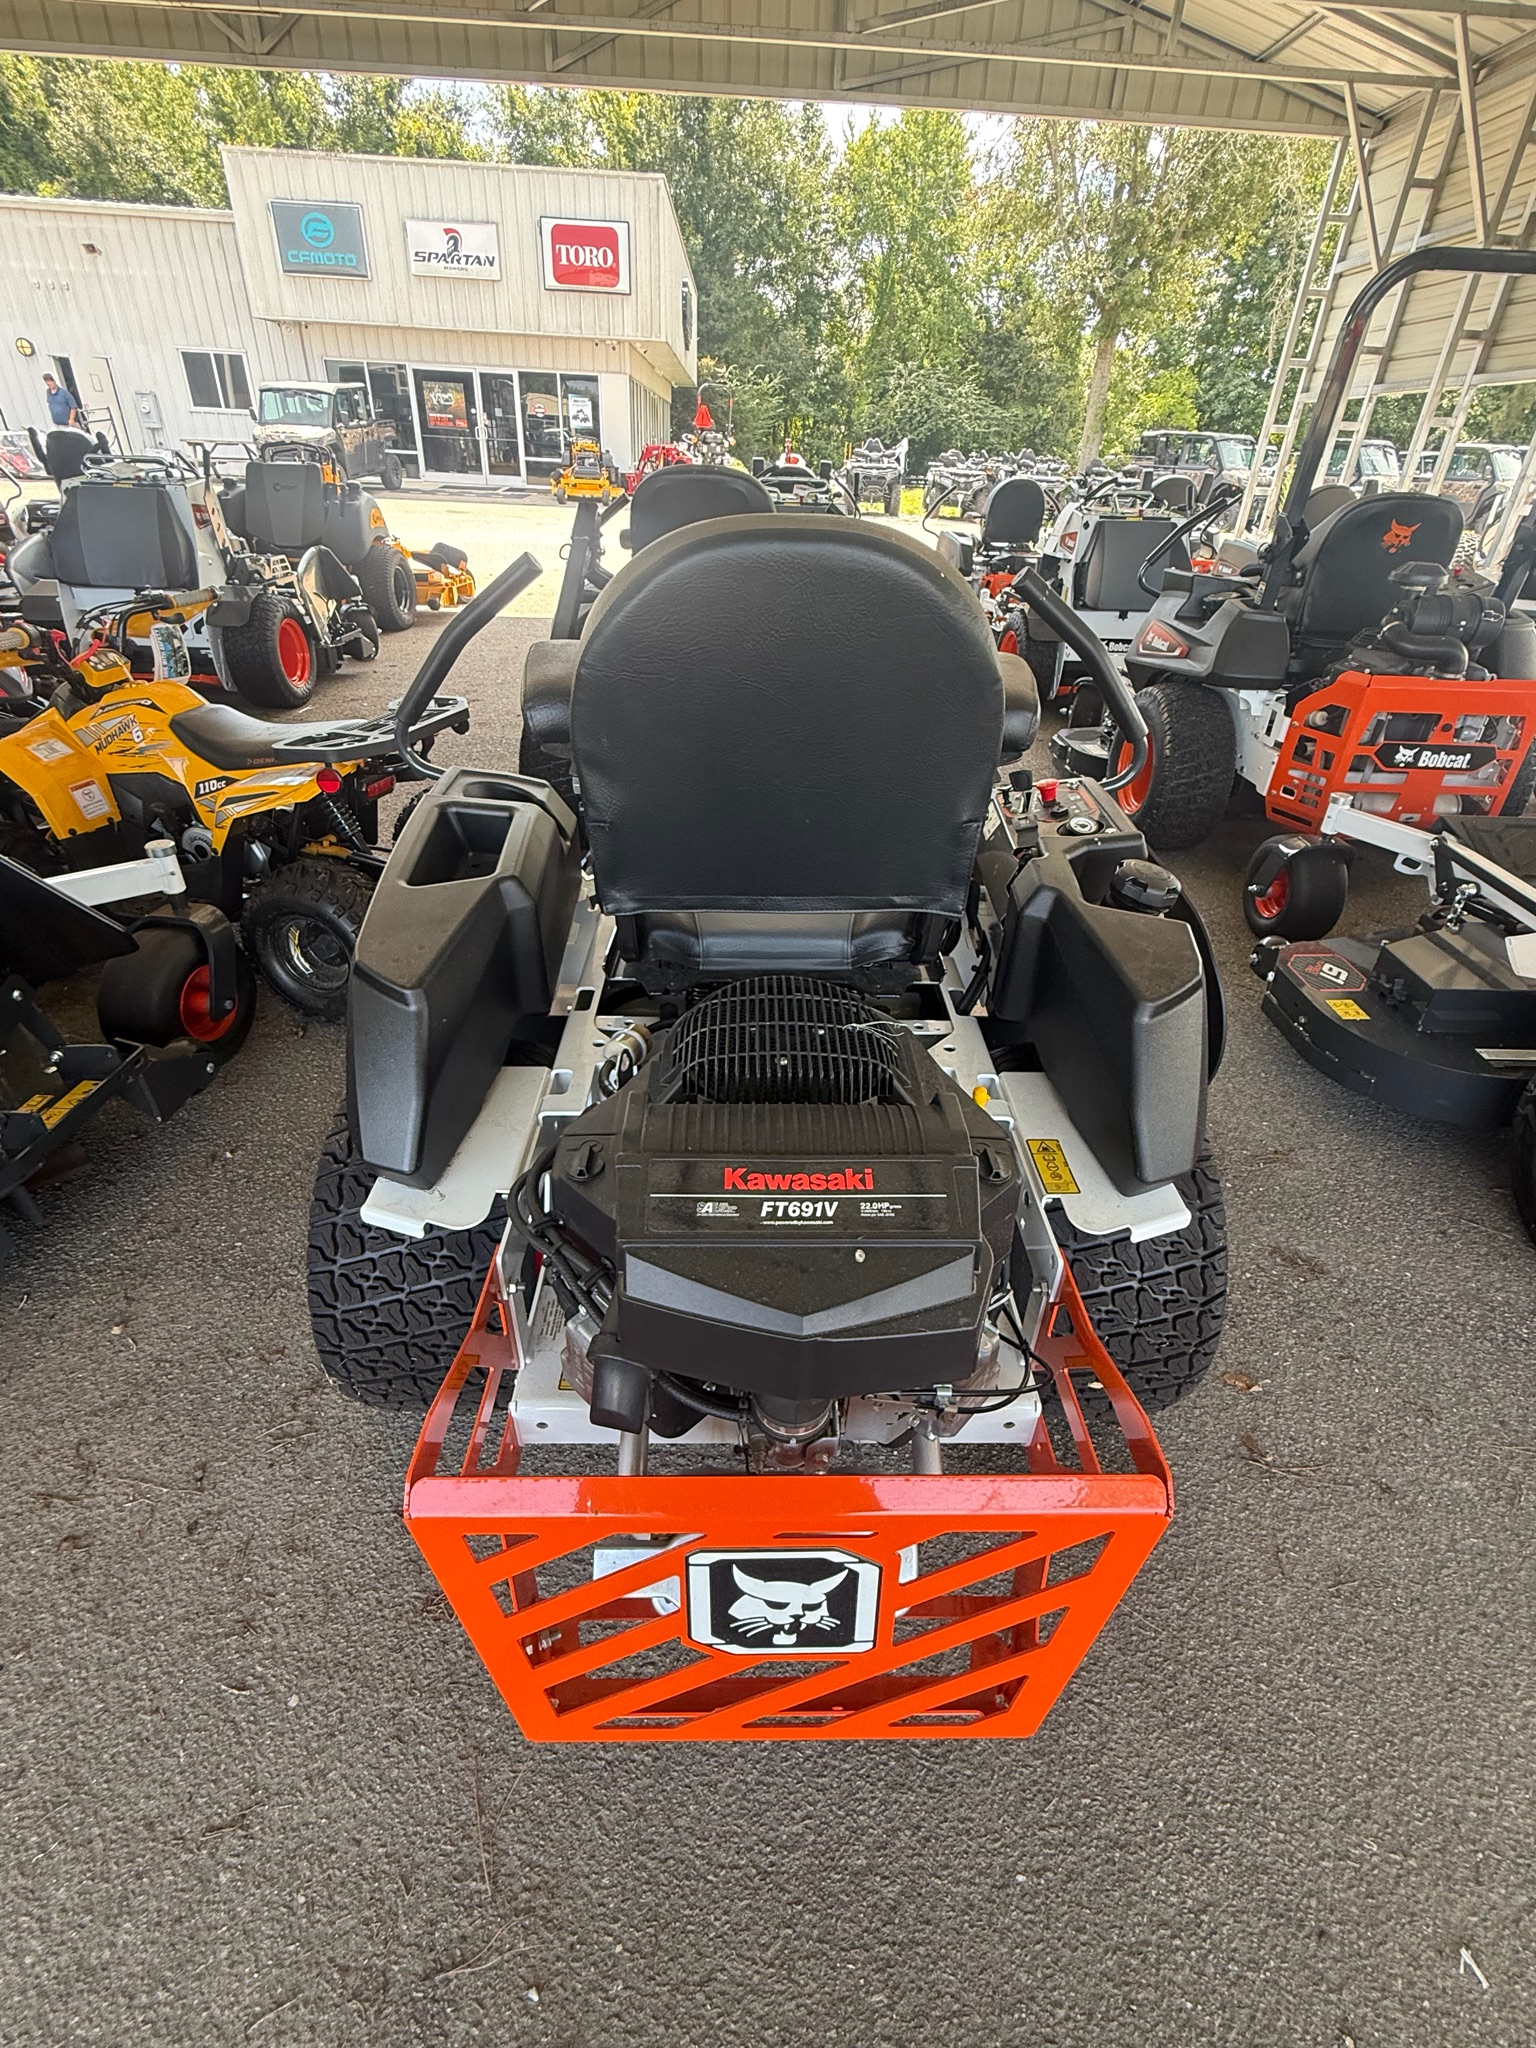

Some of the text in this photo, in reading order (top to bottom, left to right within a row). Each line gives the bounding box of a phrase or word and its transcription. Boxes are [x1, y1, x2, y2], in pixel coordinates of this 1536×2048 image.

[286, 249, 357, 268] CFMOTO
[413, 250, 496, 269] SPARTAN
[555, 243, 613, 269] TORO
[93, 713, 138, 755] MUDHAWK
[131, 726, 144, 744] 6
[1417, 750, 1470, 770] Bobcat
[198, 779, 227, 795] 110cc
[723, 1167, 875, 1191] Kawasaki
[760, 1200, 839, 1218] FT691V
